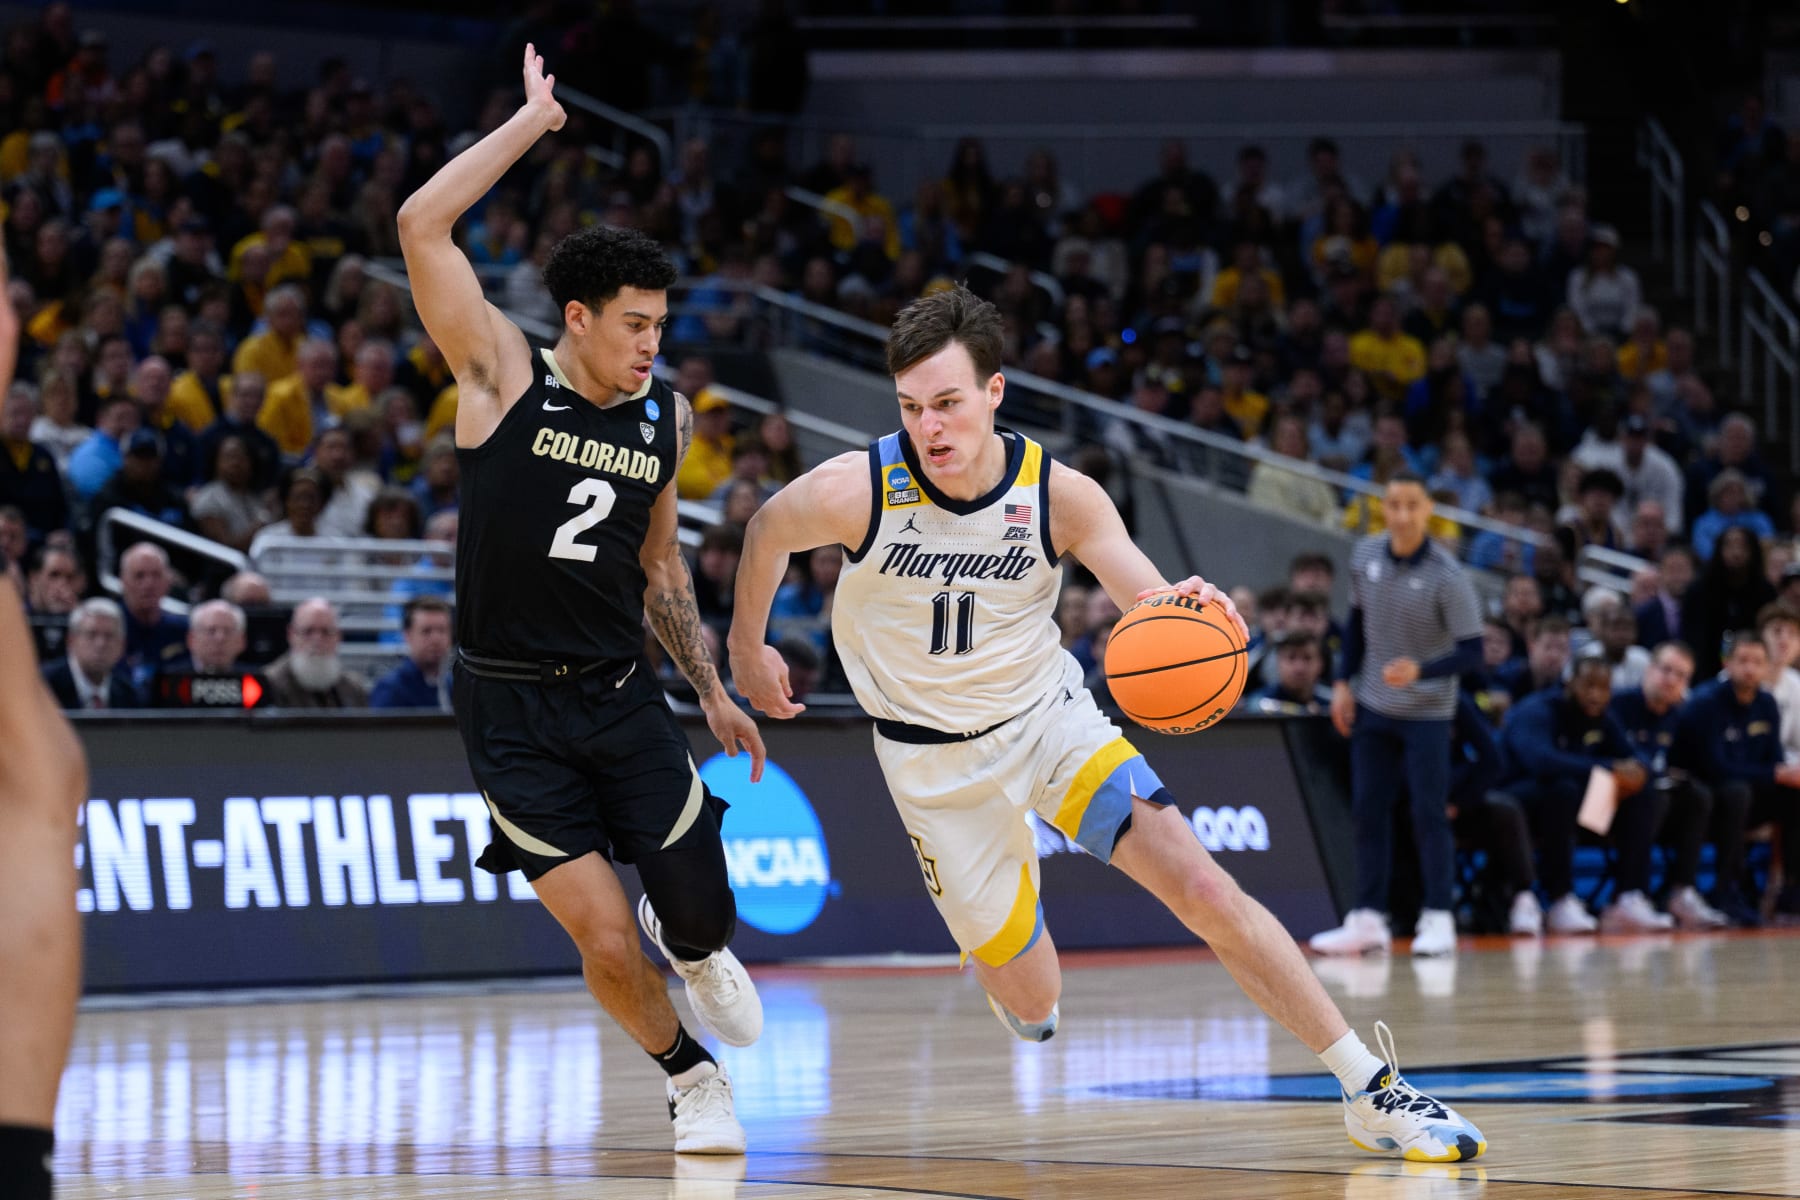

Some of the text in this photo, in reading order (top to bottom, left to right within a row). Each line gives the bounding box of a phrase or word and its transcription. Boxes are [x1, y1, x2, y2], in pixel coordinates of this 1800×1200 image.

[531, 427, 661, 484] COLORADO
[891, 476, 910, 486] NCAA
[548, 477, 617, 563] 2
[1008, 526, 1028, 534] BIG
[879, 542, 1036, 587] Marquette
[928, 591, 975, 655] 11
